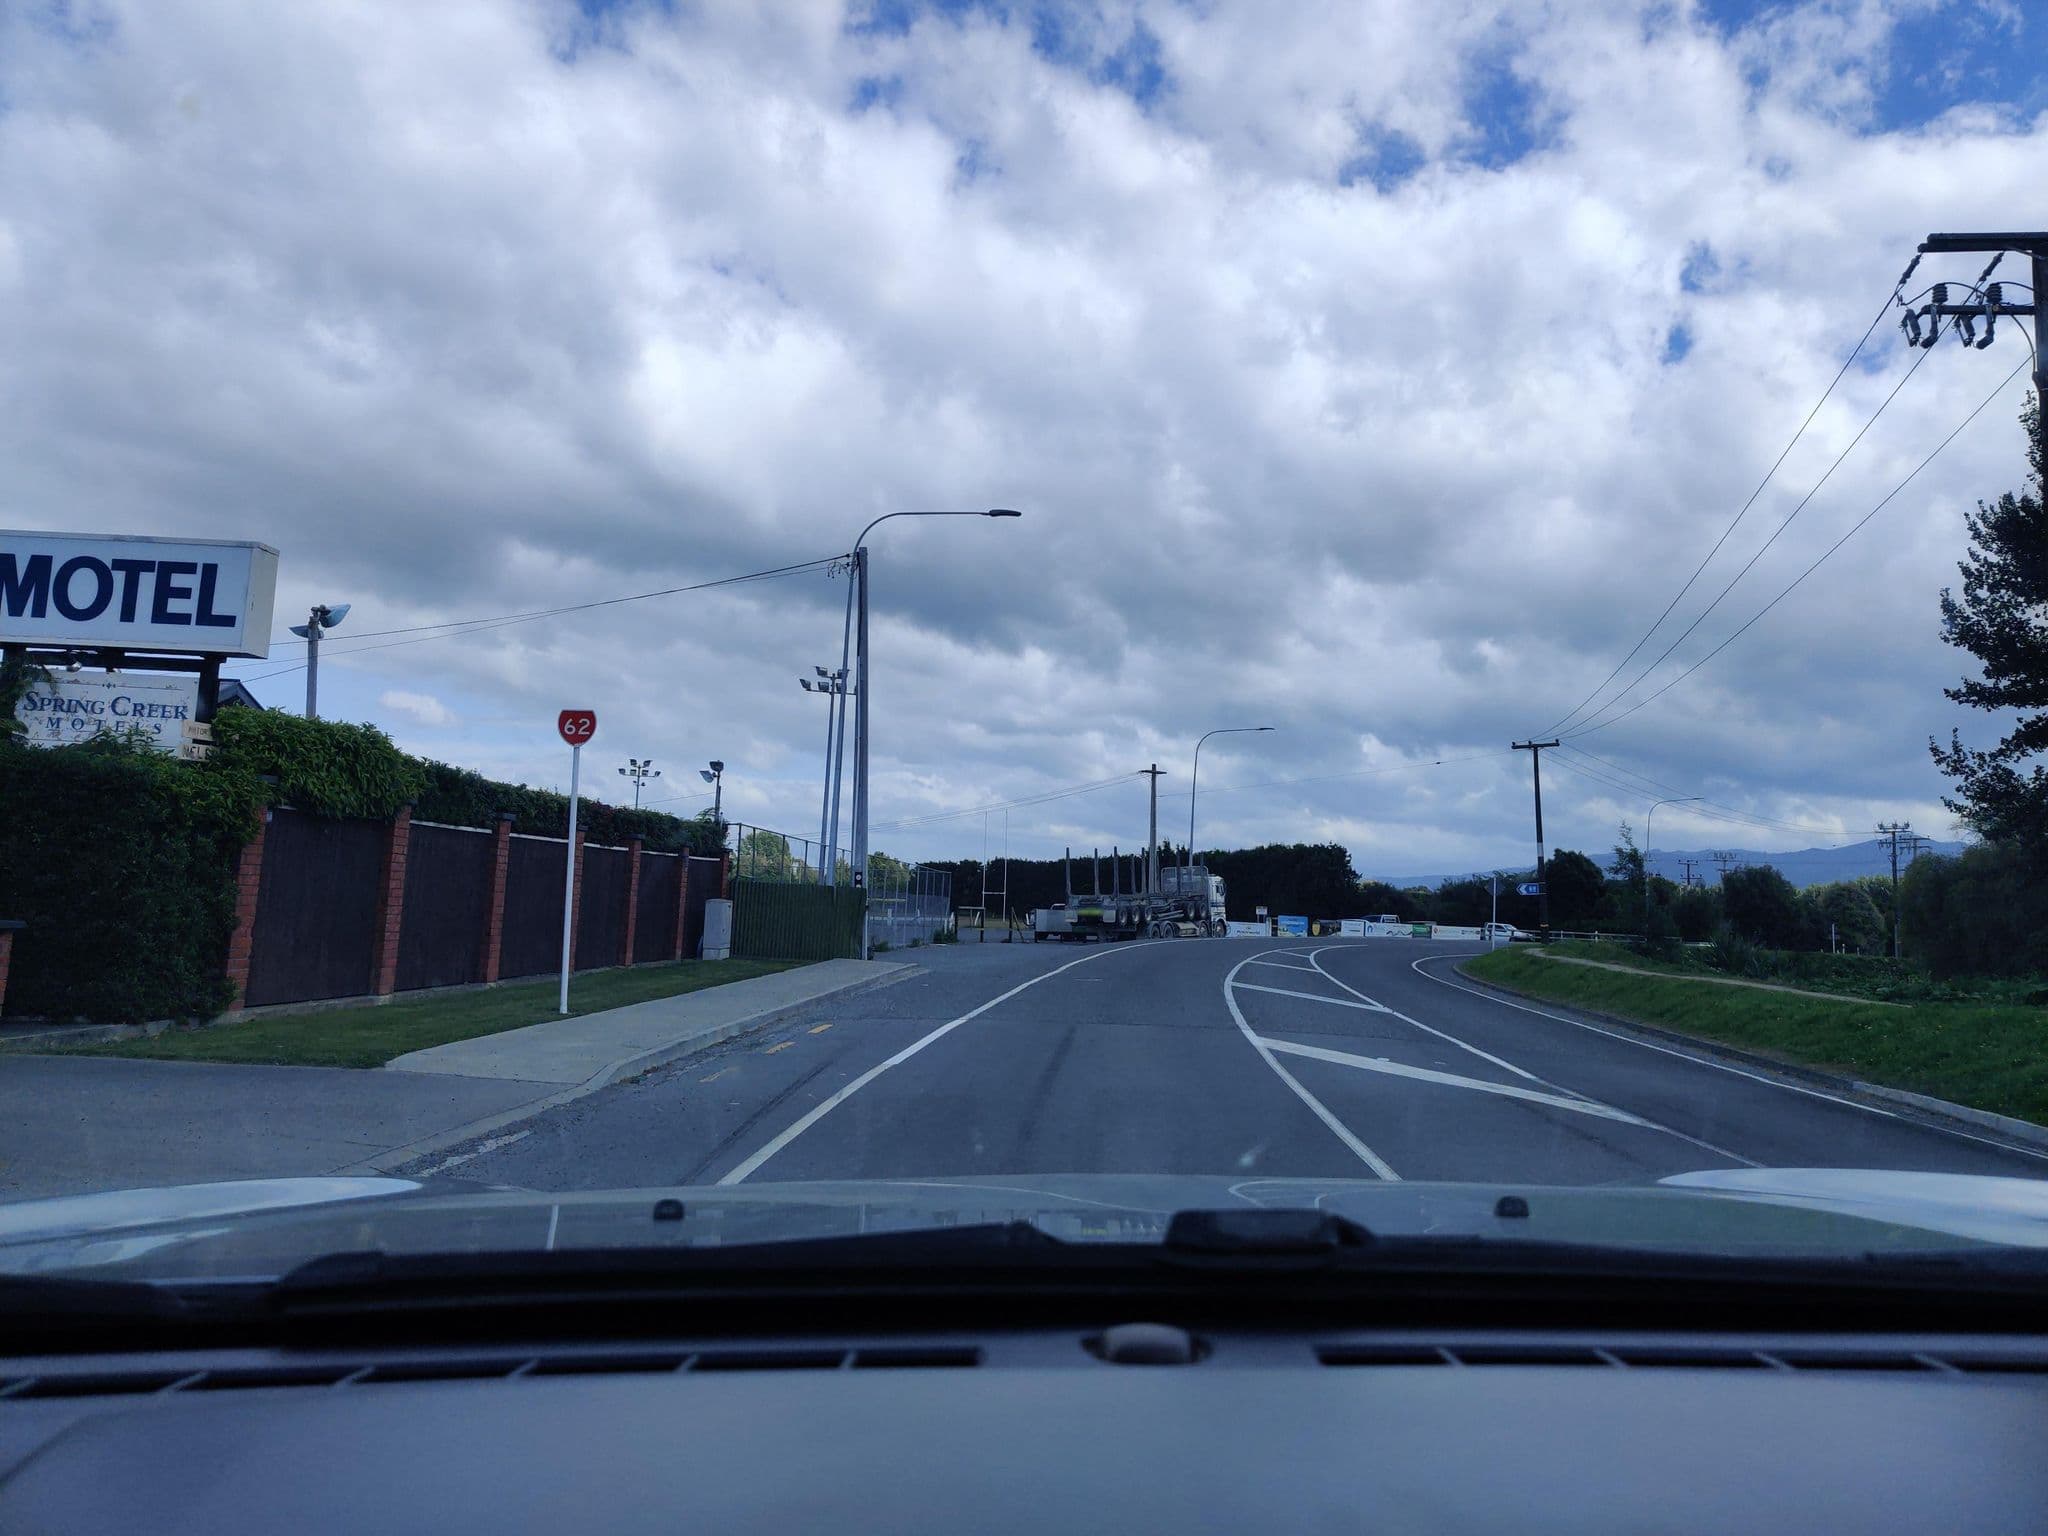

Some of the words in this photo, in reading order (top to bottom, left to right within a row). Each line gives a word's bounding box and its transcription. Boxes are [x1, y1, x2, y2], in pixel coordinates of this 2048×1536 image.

[0, 553, 236, 627] MOTEL
[23, 691, 105, 715] SPRING
[110, 696, 188, 720] CREEK
[564, 718, 590, 735] 62
